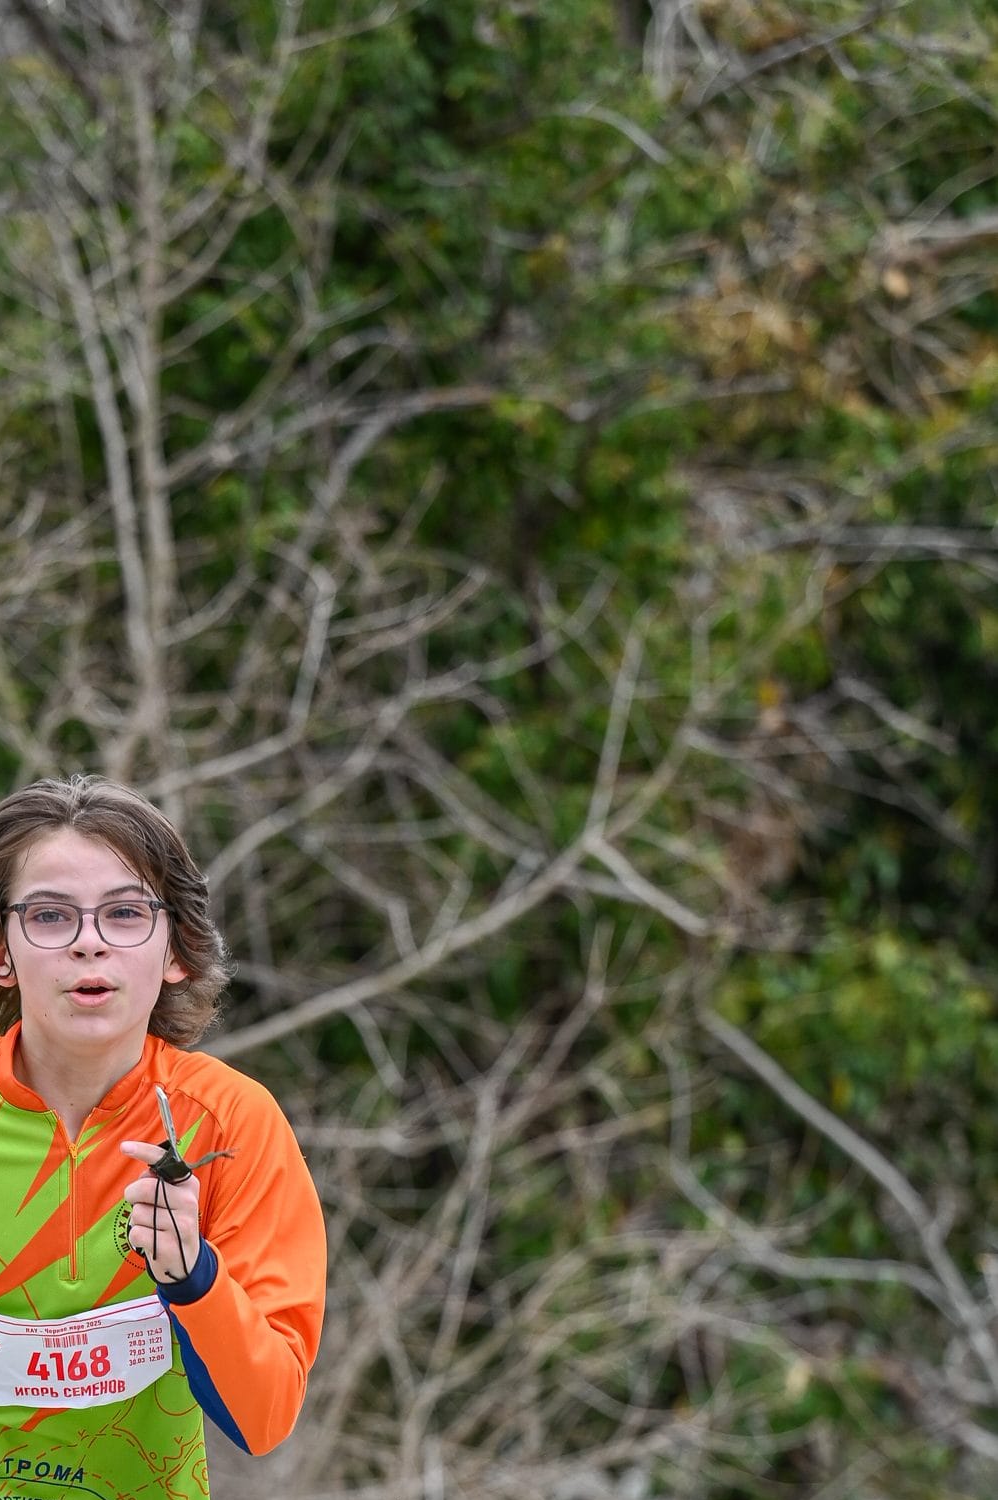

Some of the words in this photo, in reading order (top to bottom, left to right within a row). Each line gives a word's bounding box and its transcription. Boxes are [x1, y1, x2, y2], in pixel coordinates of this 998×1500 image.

[86, 1320, 102, 1328] 2025
[127, 1331, 143, 1339] 27.03
[128, 1339, 146, 1347] 28.03
[129, 1348, 146, 1356] 29.03
[149, 1345, 163, 1353] 14:17
[27, 1345, 111, 1381] 4168
[129, 1357, 145, 1366] 30.03
[149, 1354, 165, 1362] 12:00
[14, 1386, 59, 1398] ИГОРЬ
[63, 1379, 126, 1398] СЕМЕНОВ
